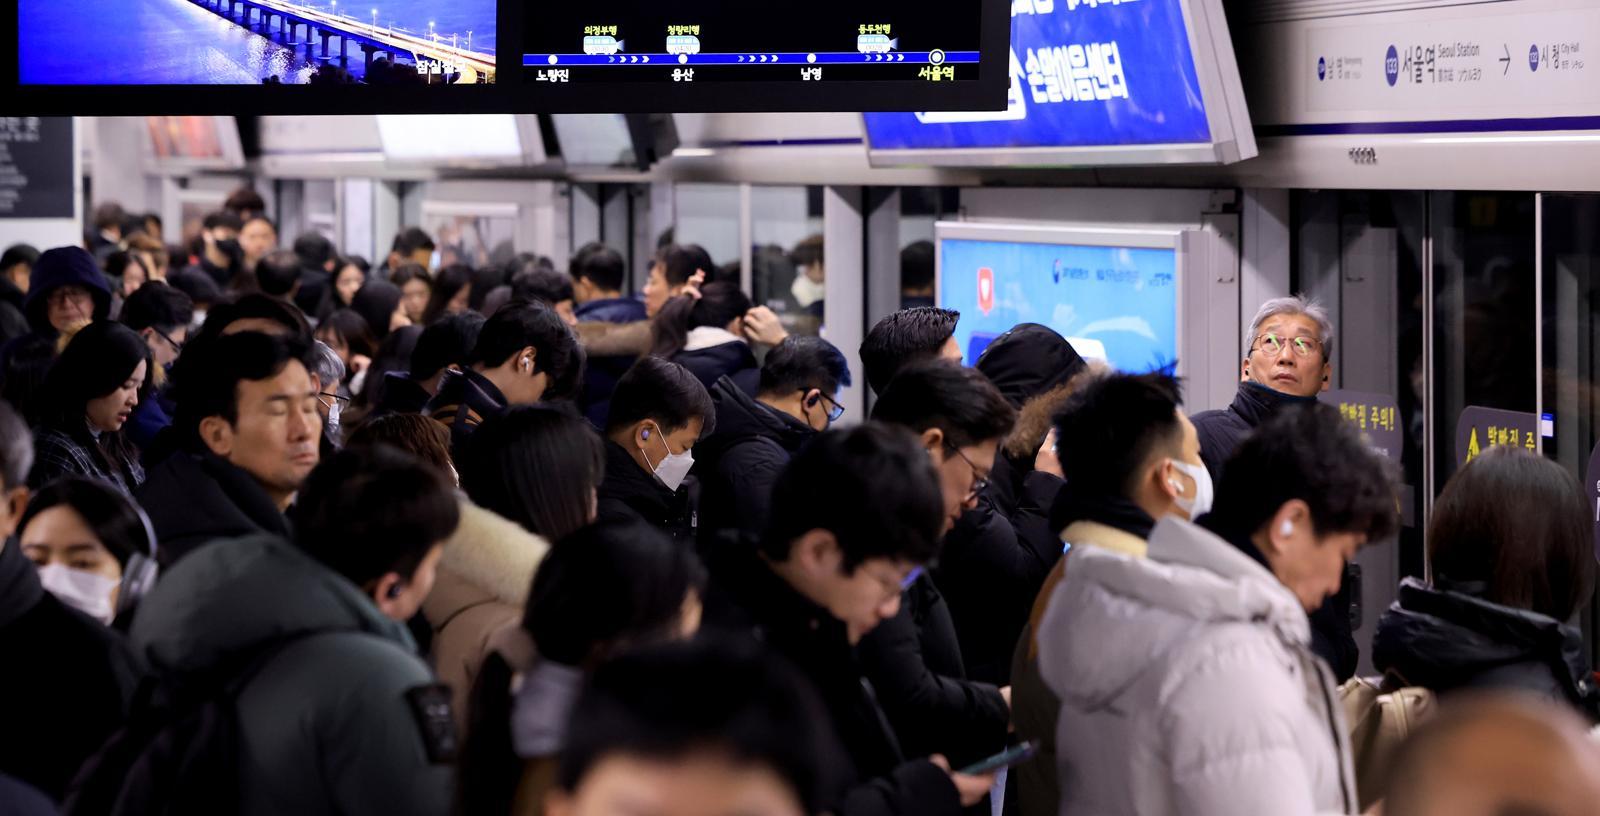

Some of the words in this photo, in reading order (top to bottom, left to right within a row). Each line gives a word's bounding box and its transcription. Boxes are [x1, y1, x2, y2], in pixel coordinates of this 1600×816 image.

[584, 25, 617, 36] 의정부행
[667, 25, 700, 36] 청량리행
[858, 23, 891, 35] 동두천행
[1438, 43, 1456, 57] Seoul
[1457, 41, 1480, 56] Station
[1386, 57, 1398, 74] 133
[1402, 45, 1436, 83] 서울역
[536, 68, 569, 83] 노량진
[671, 68, 695, 82] 용산
[801, 67, 822, 81] 남영
[918, 65, 955, 81] 서울역
[1025, 40, 1129, 104] 손말이음센터
[1371, 405, 1394, 431] 주의!
